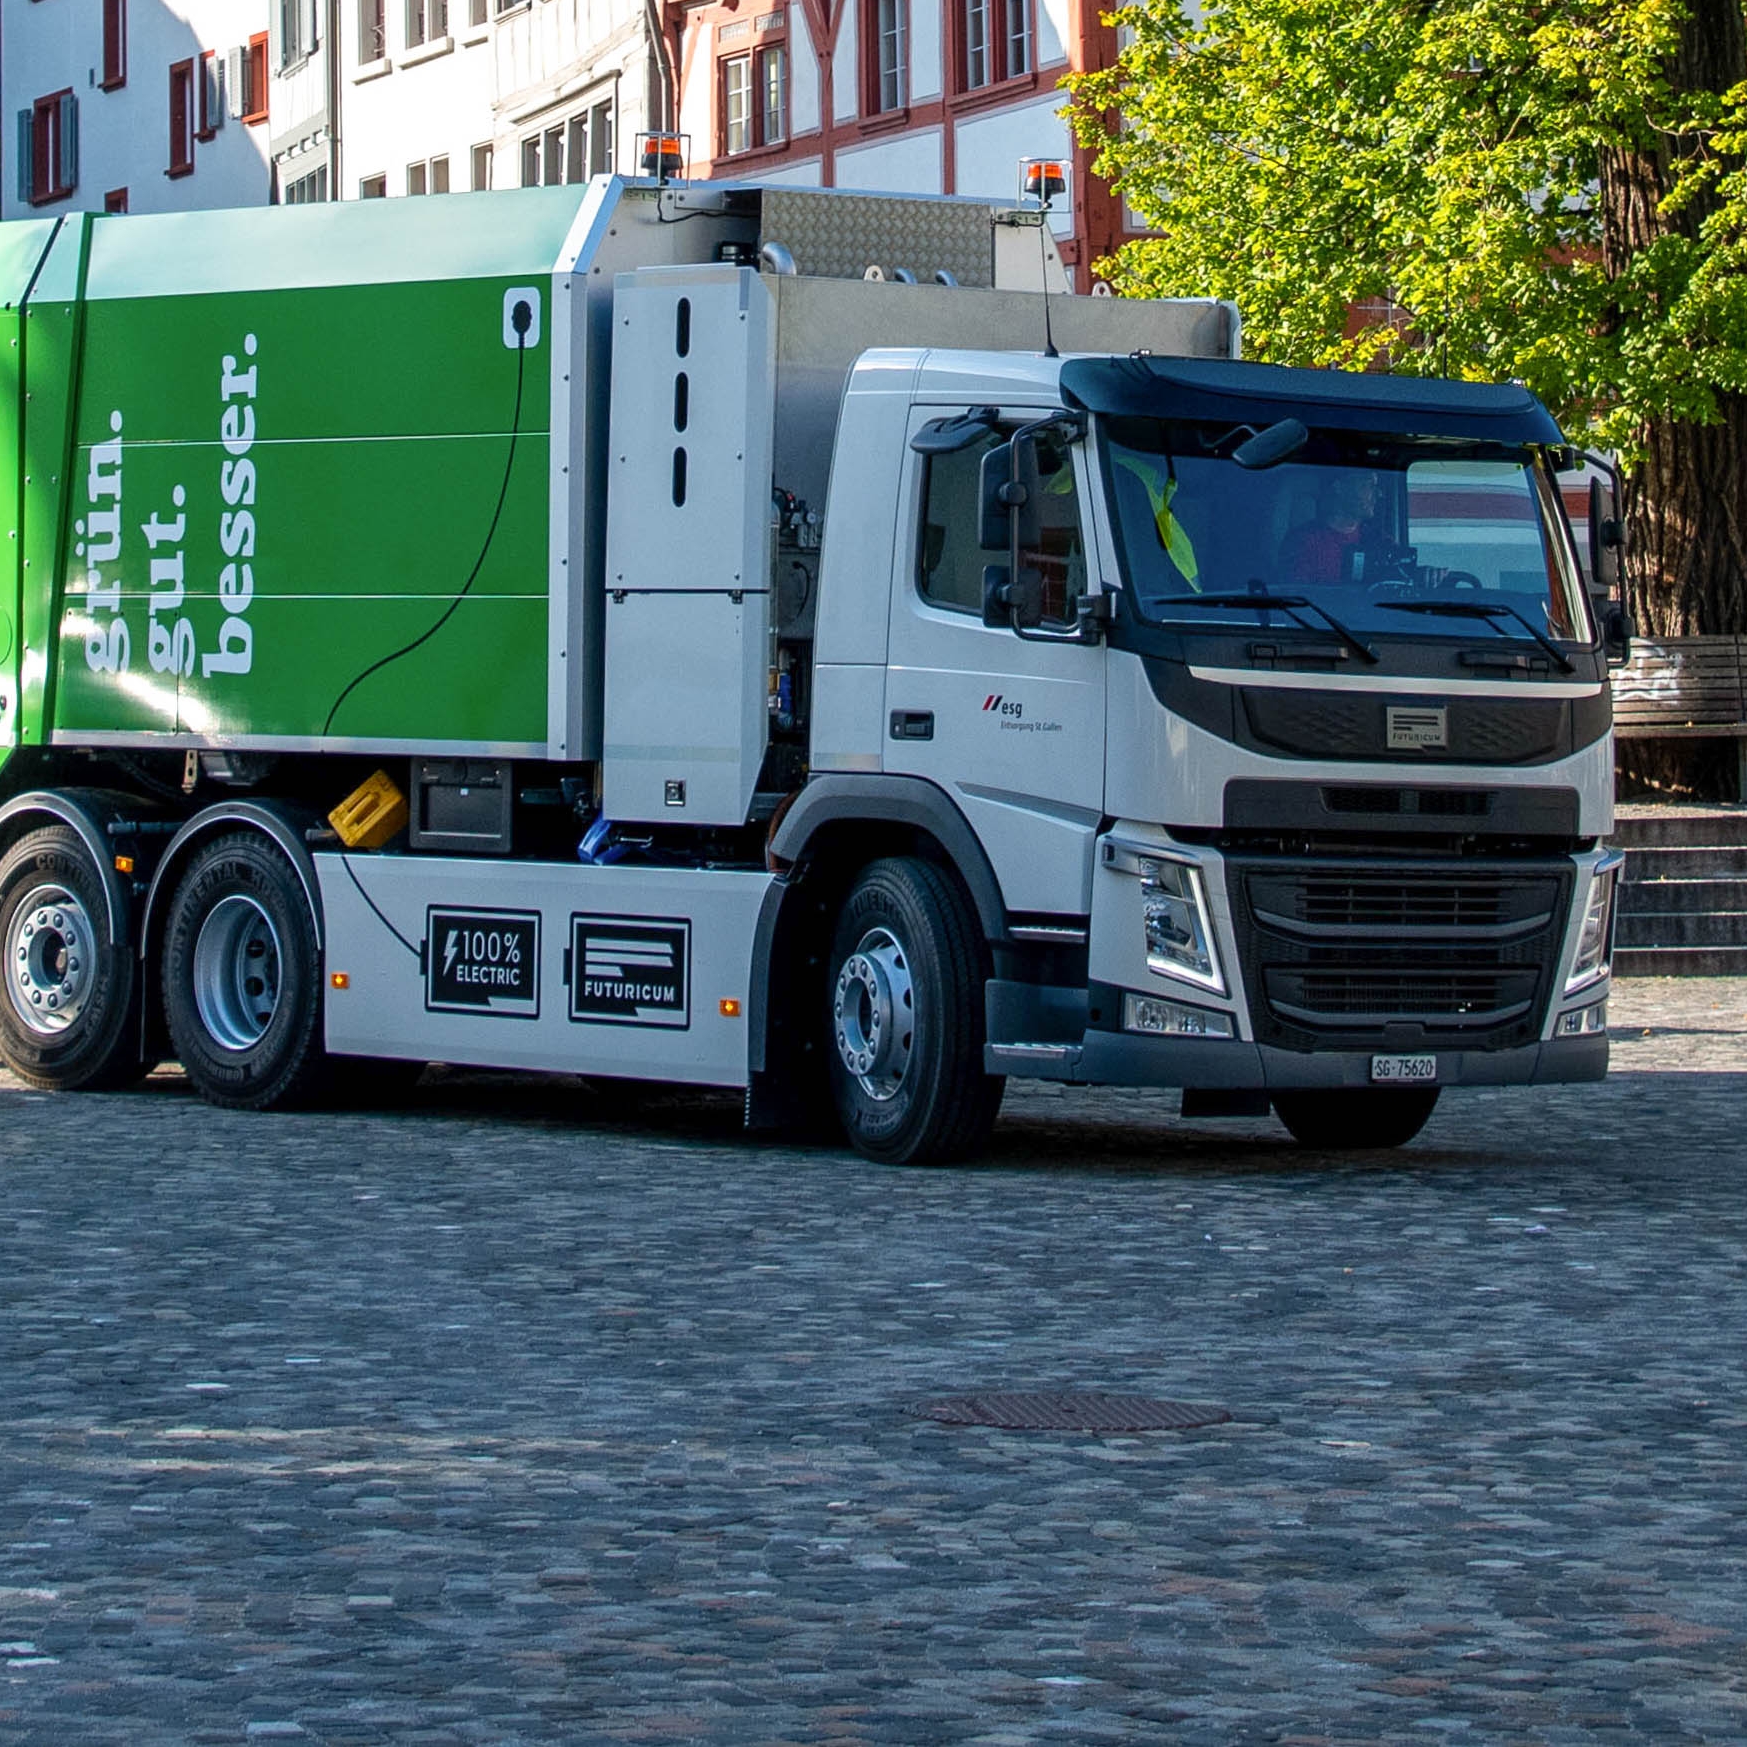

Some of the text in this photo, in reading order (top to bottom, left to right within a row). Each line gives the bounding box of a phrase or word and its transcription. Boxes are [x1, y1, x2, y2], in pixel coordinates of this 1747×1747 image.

[202, 333, 257, 678] besser.
[75, 410, 130, 673] grün.
[141, 484, 195, 678] gut.
[1001, 702, 1022, 718] esg
[462, 930, 520, 963] 100%
[456, 965, 520, 985] ELECTRIC
[585, 981, 674, 1002] FUTURICUM
